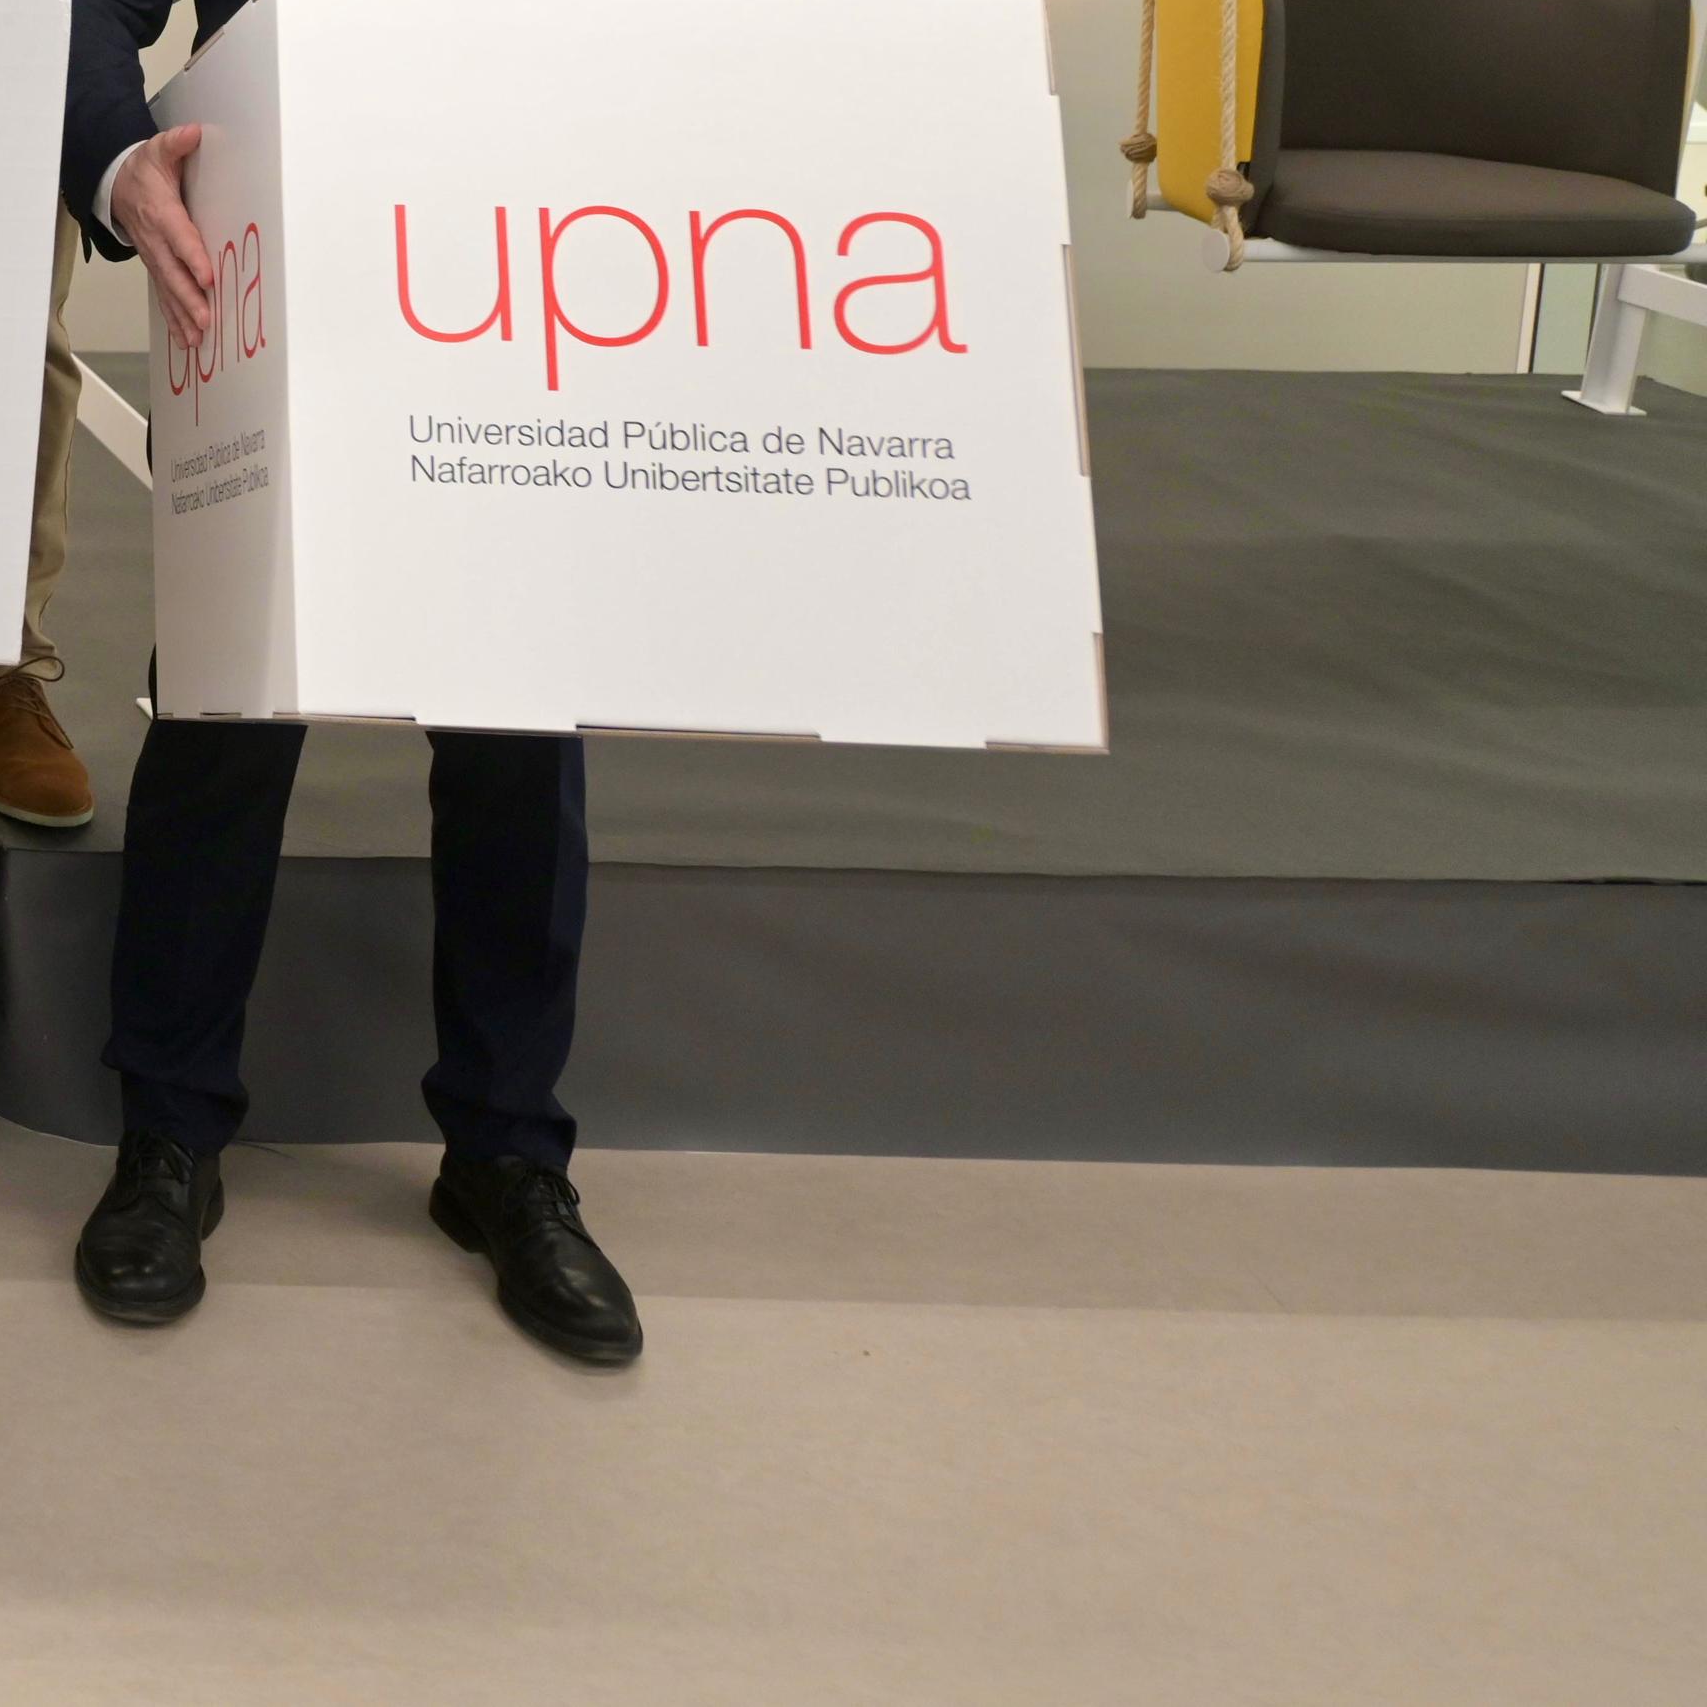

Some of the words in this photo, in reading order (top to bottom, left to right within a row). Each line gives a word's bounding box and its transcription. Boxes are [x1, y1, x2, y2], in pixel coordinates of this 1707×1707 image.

[393, 202, 968, 392] upna
[409, 414, 609, 449] Universidad
[621, 420, 749, 454] Pública
[762, 426, 805, 456] de
[818, 427, 955, 461] Navarra
[410, 455, 593, 489] Nafarroako
[604, 460, 814, 496] Unibertsitate
[826, 468, 972, 502] Publikoa
